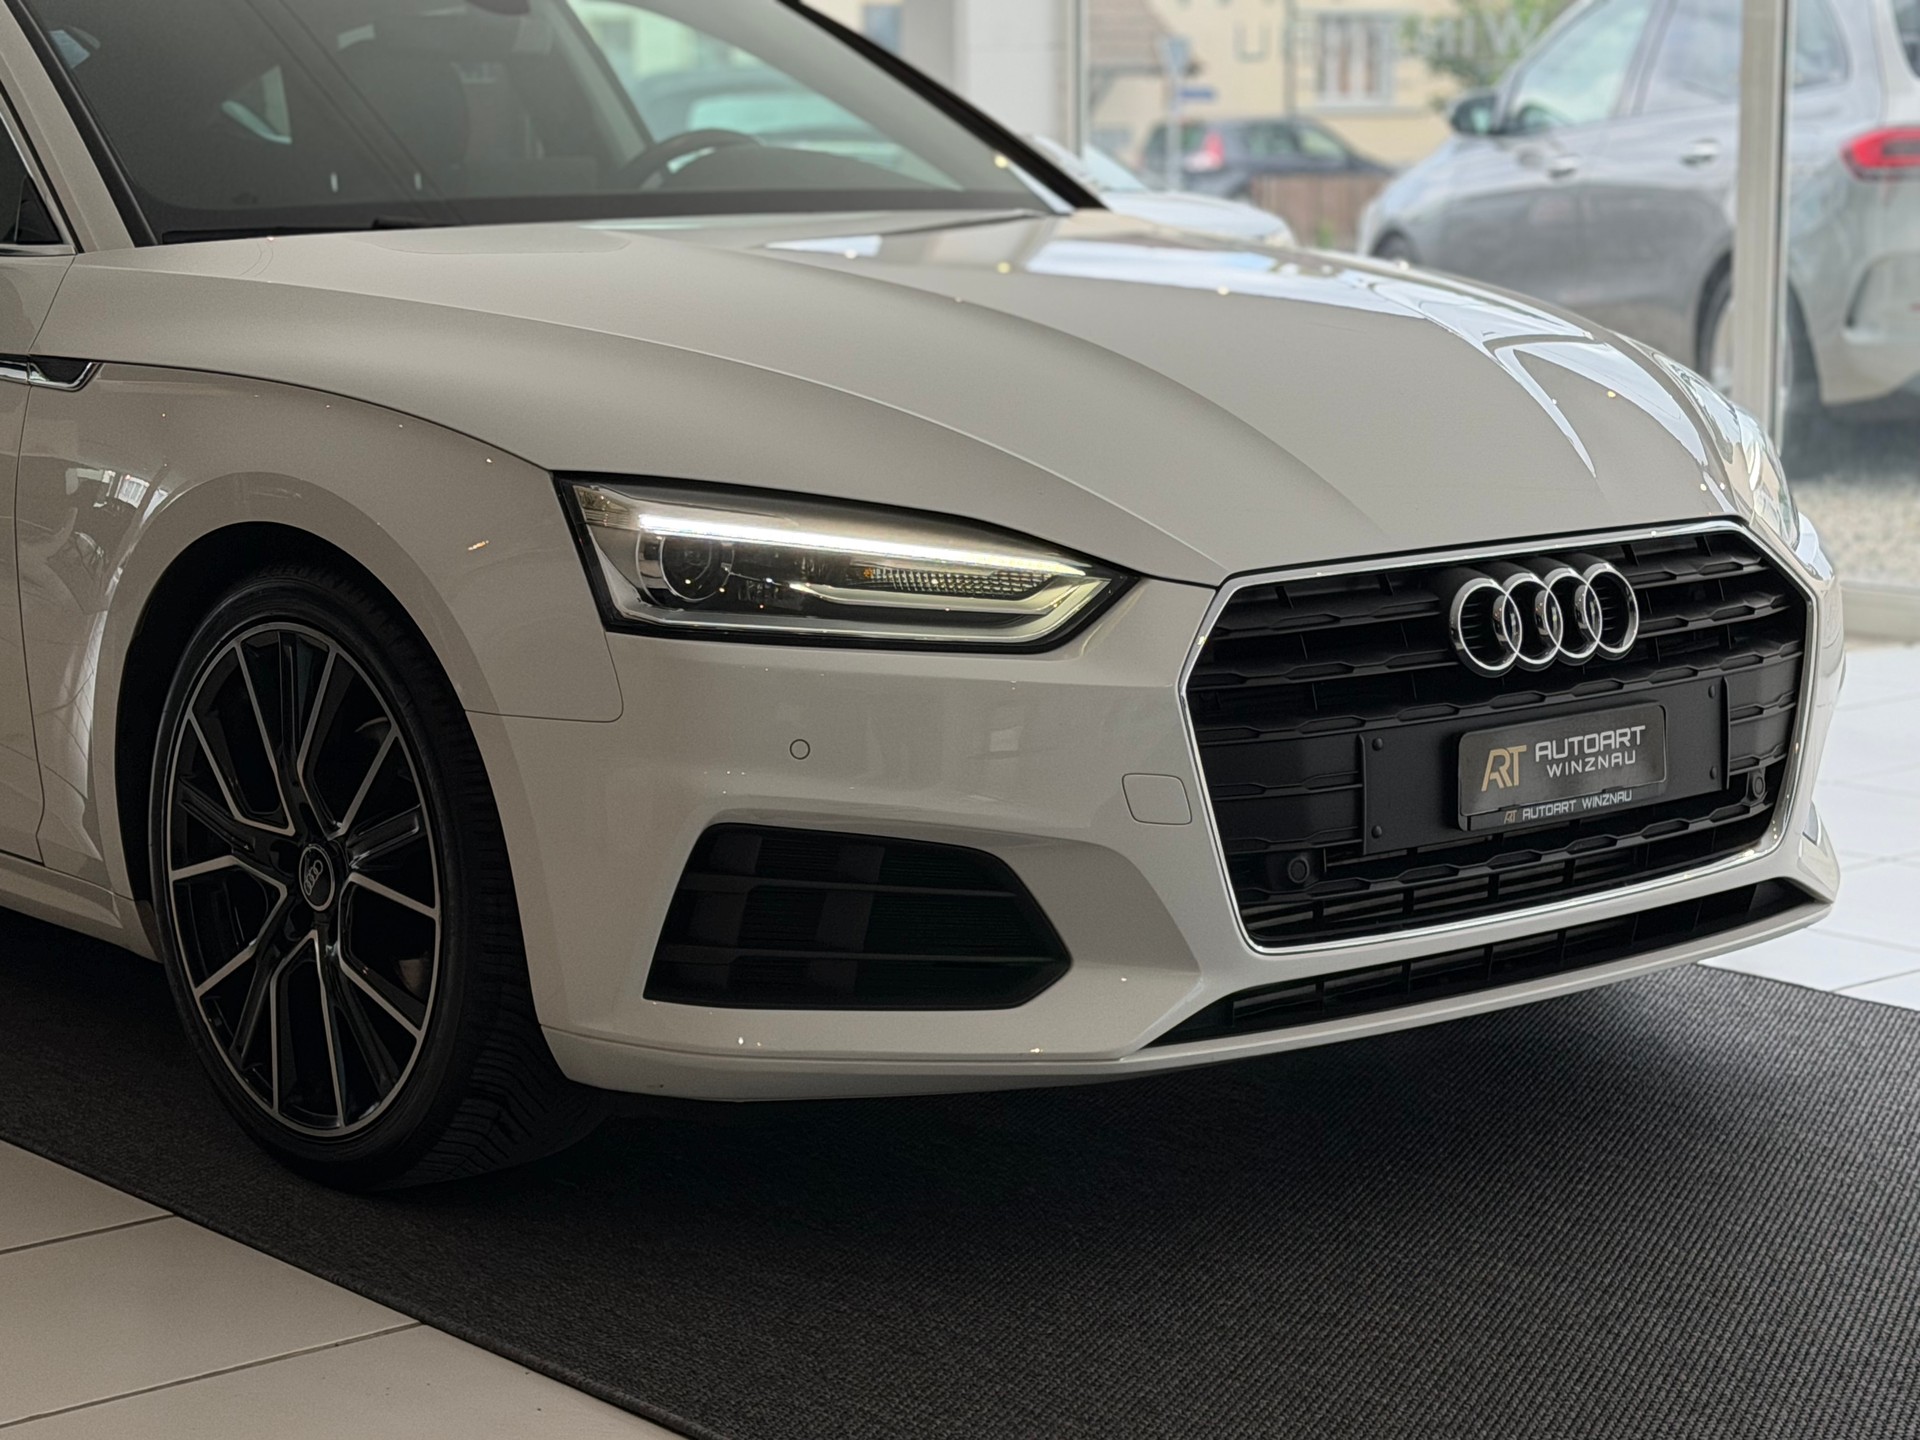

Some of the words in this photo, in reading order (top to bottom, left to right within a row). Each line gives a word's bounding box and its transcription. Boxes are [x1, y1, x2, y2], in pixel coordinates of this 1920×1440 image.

[1535, 725, 1646, 762] AUTOART
[1546, 750, 1636, 778] WINZNAU
[1522, 800, 1577, 821] AUTOART
[1581, 789, 1632, 810] WINZNAU
